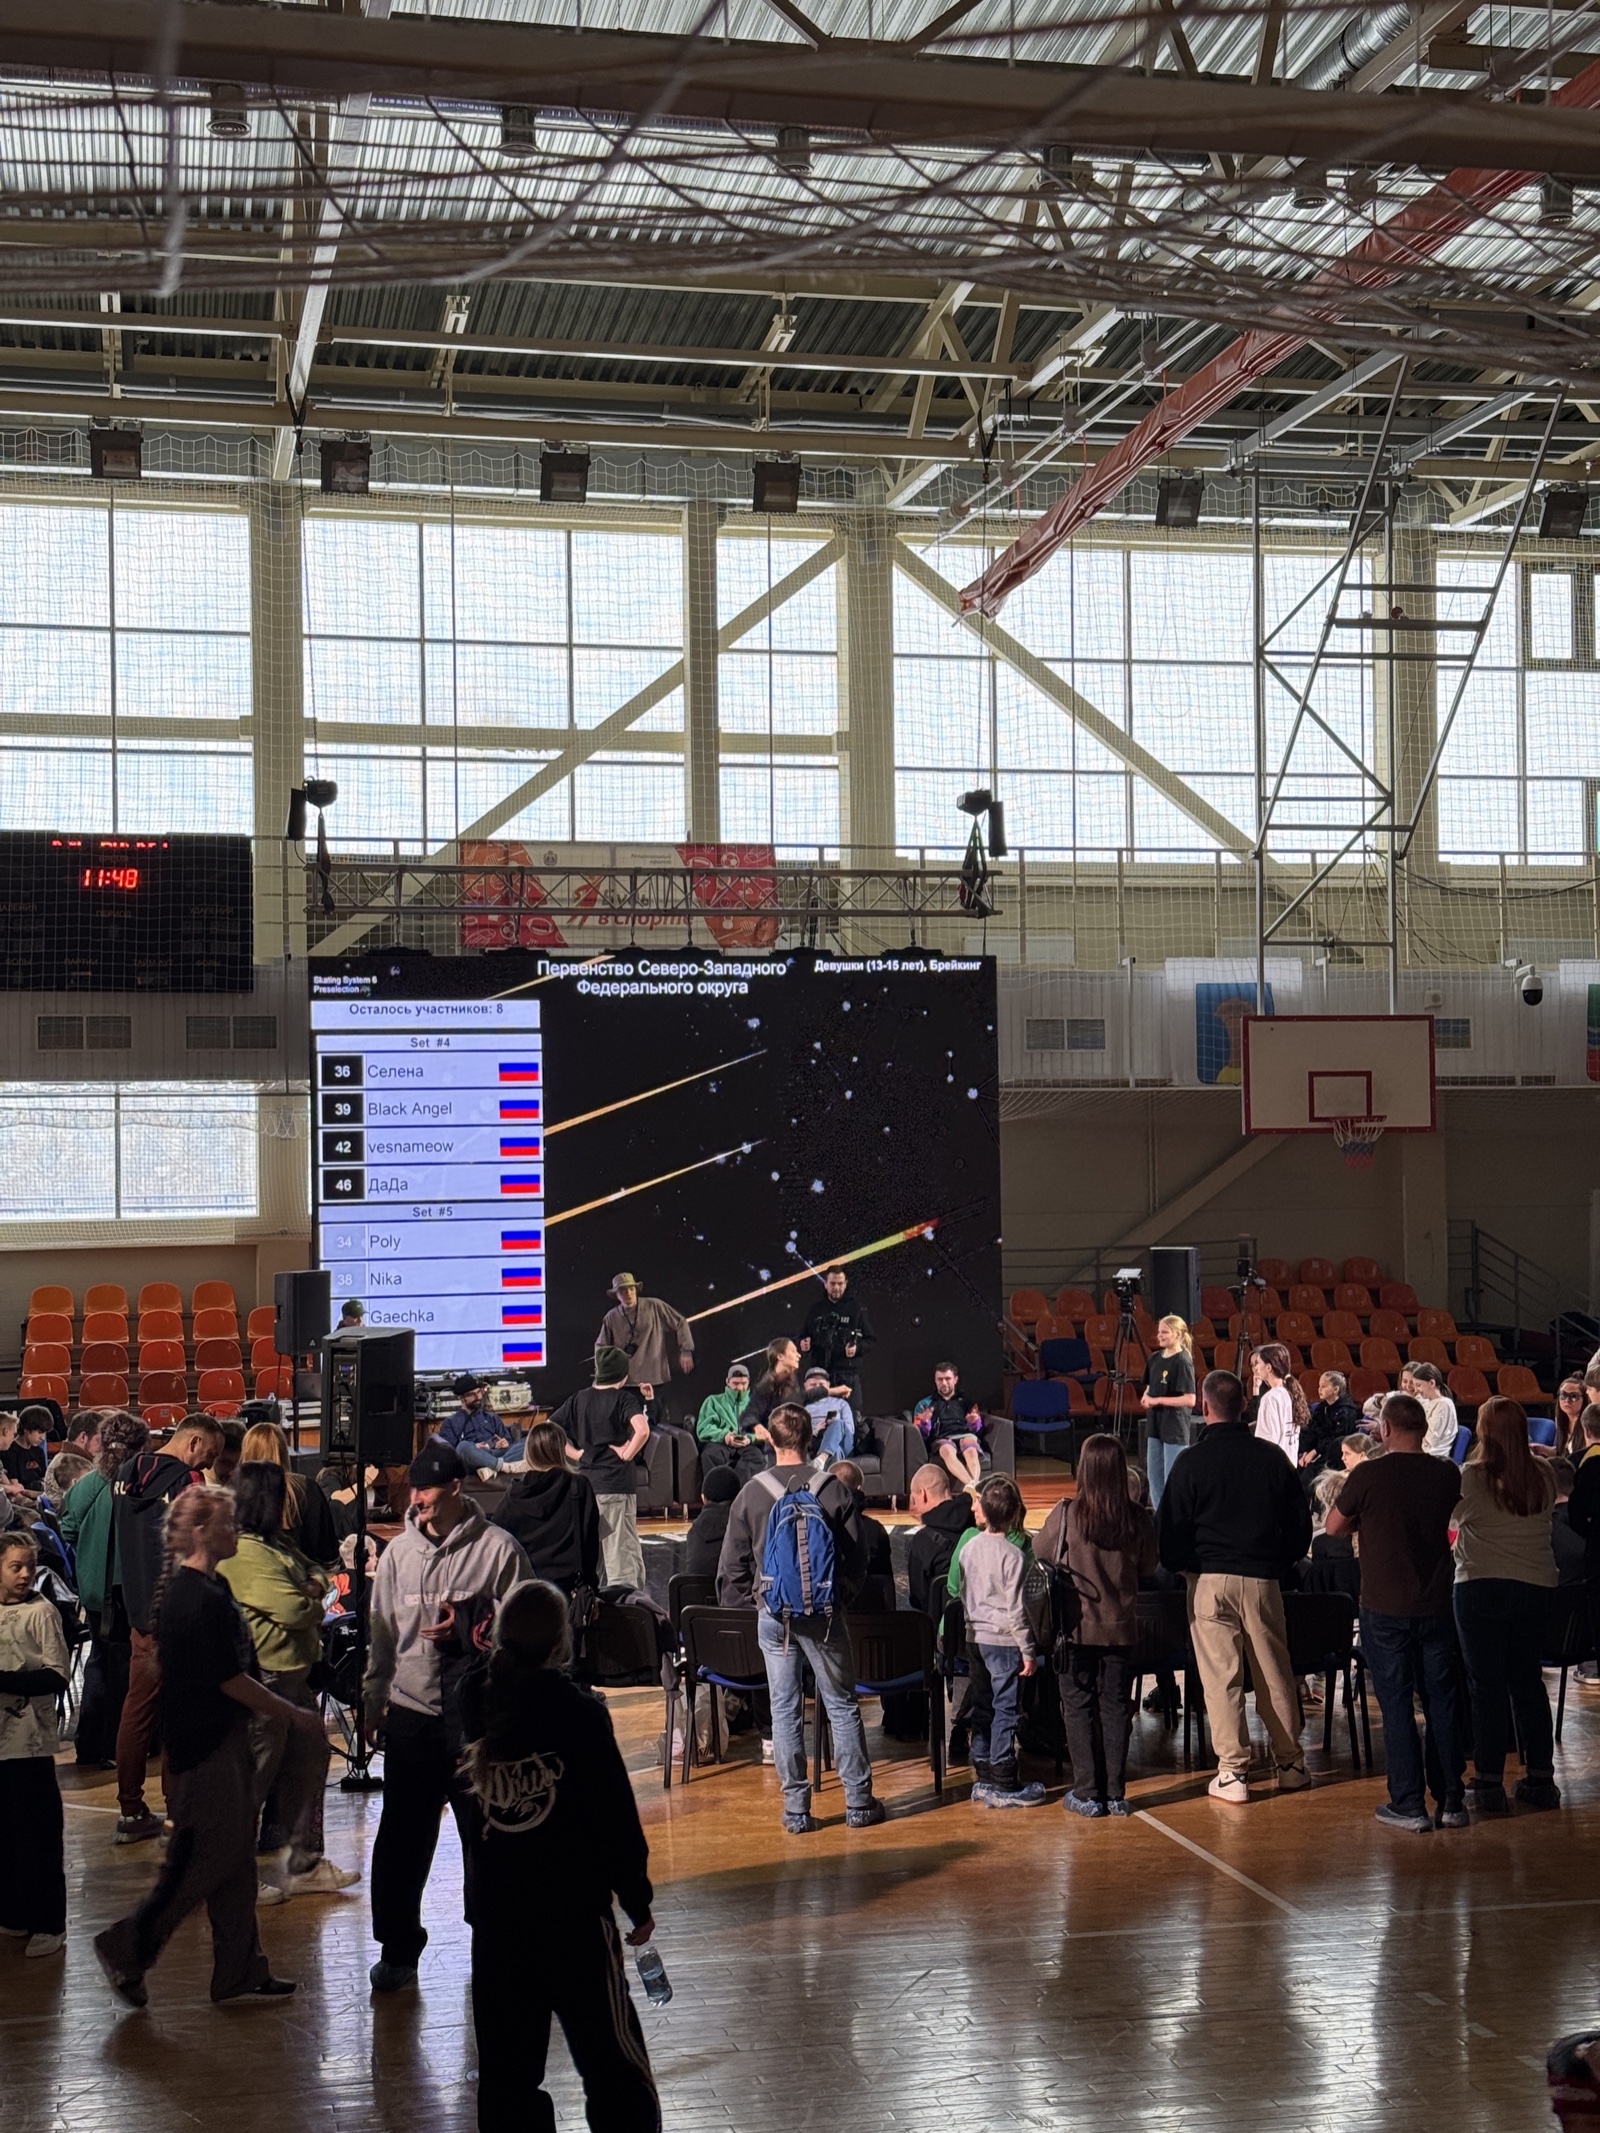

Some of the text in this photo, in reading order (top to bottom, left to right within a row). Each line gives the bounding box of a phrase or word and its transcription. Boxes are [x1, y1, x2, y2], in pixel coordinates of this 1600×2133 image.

[537, 959, 787, 979] Первенство Северо-Западного
[814, 959, 864, 973] Девушки
[929, 958, 981, 973] Брейкинг
[313, 975, 341, 985] Skating
[342, 975, 371, 985] System
[313, 985, 360, 993] Preselection
[577, 980, 748, 997] Федерального округа
[349, 1004, 503, 1017] Осталось участников: 8
[410, 1037, 450, 1048] Set #4
[334, 1065, 424, 1078] 36 Селена
[335, 1101, 452, 1118] 39 Black Angel
[335, 1140, 454, 1153] 42 vesnameow
[335, 1178, 408, 1194] 46 ДаДа
[412, 1206, 453, 1217] Set #5
[337, 1234, 401, 1251] 34 Poly
[337, 1272, 402, 1286] 38 Nika
[370, 1310, 434, 1324] Gaechka
